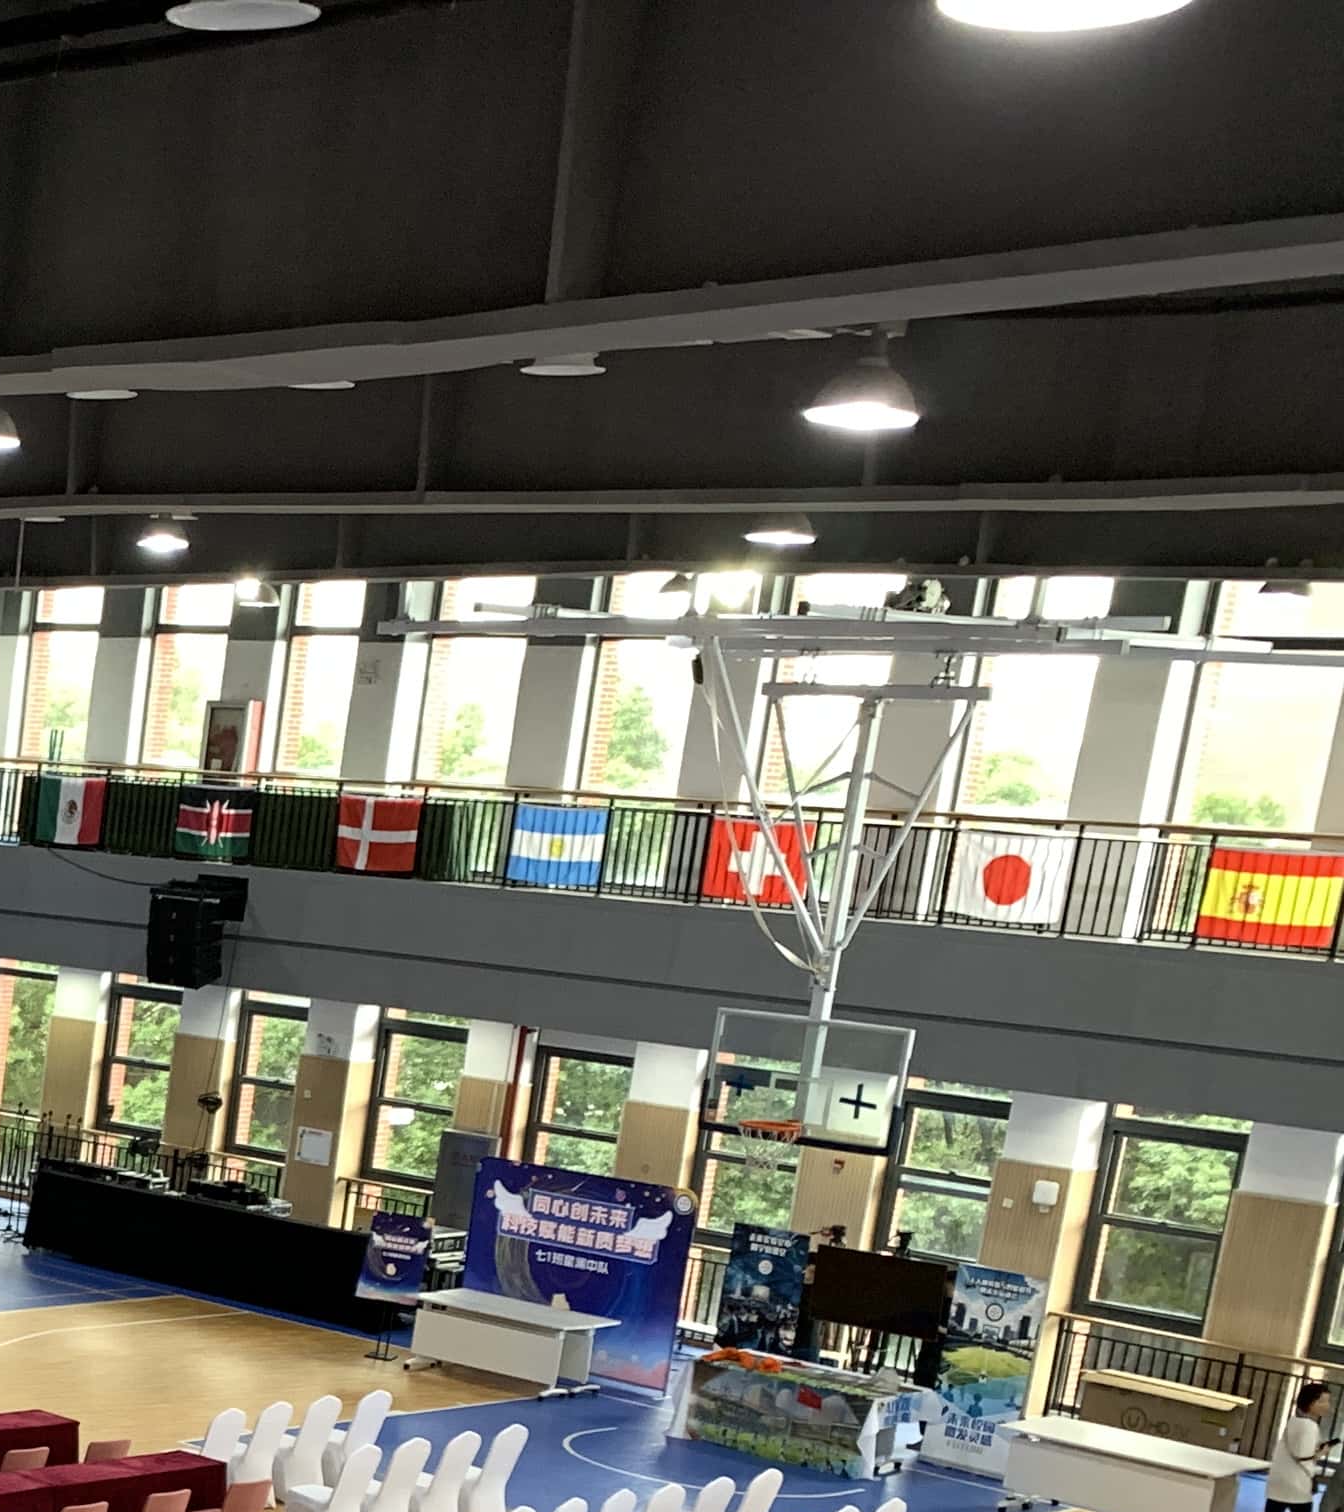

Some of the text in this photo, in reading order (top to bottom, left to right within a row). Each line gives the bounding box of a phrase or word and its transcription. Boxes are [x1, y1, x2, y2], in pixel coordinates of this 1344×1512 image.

[532, 1194, 629, 1230] 同心创未来
